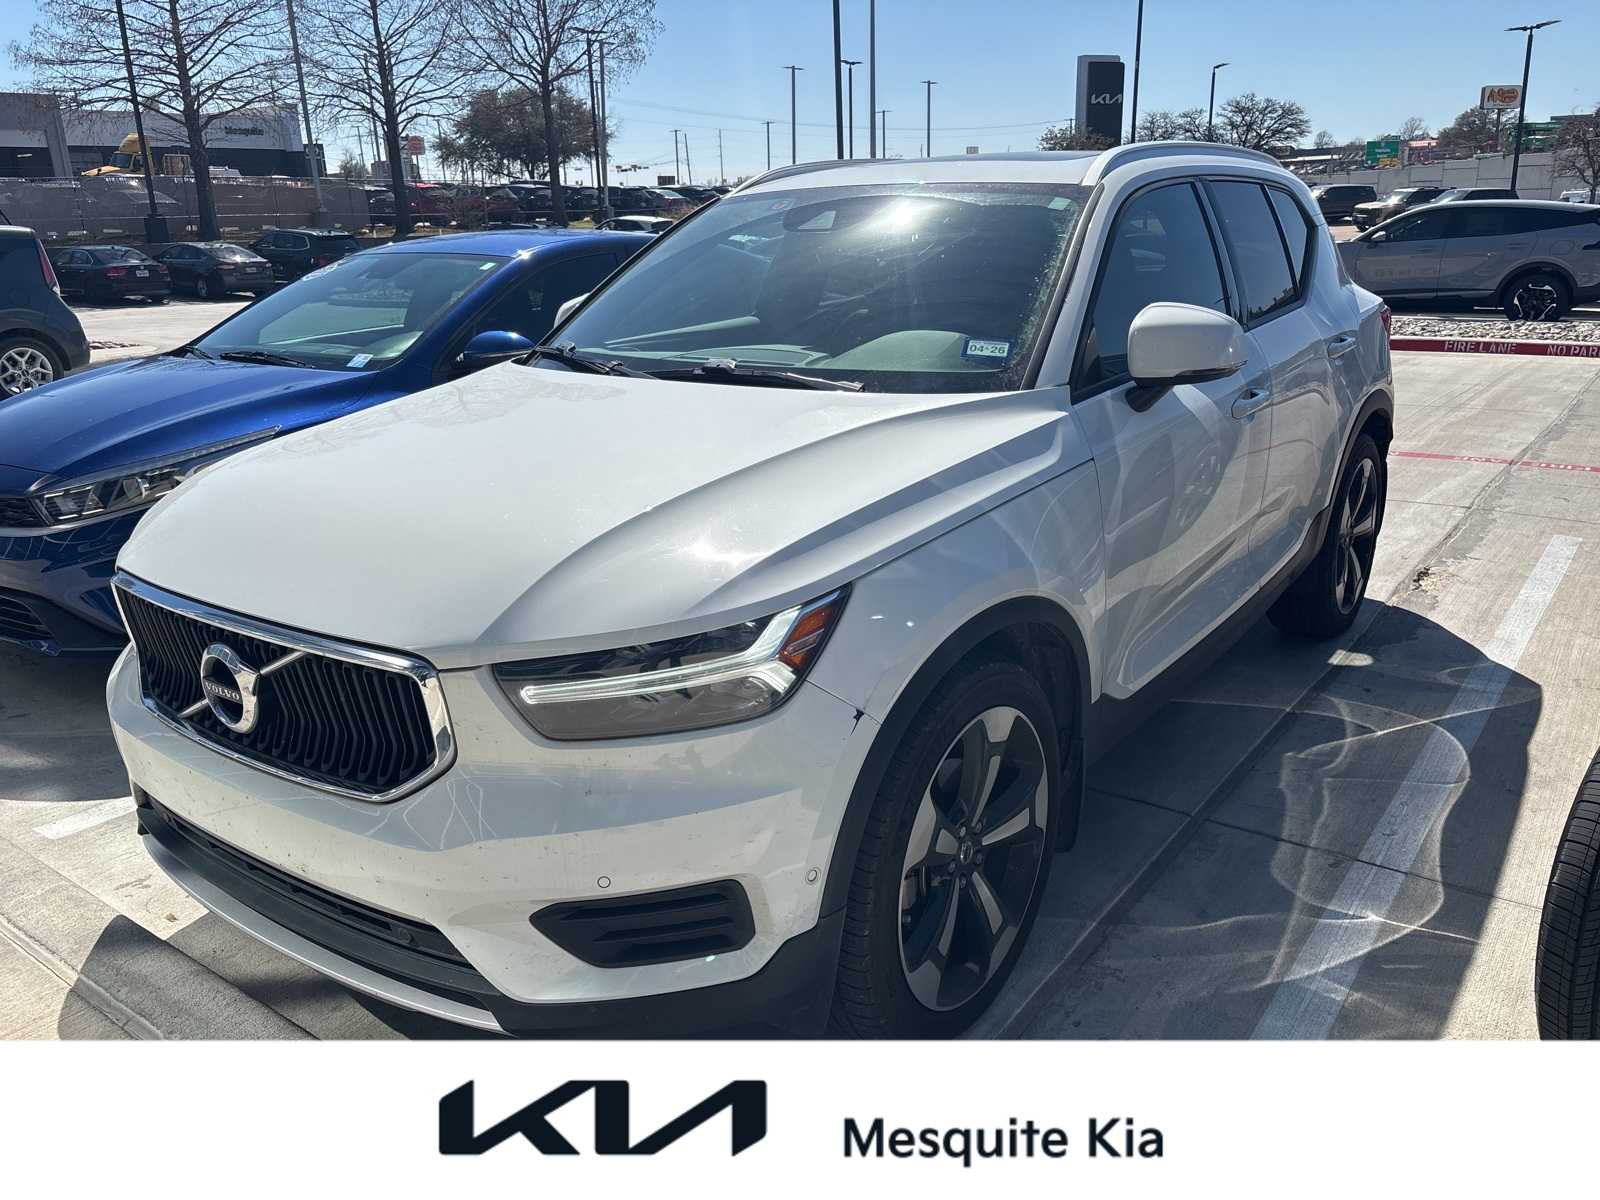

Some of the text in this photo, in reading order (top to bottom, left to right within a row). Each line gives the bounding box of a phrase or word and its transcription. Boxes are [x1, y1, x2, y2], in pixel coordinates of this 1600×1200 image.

[1443, 341, 1600, 357] FIRE LANE NO PAR
[205, 681, 240, 700] VOLVO
